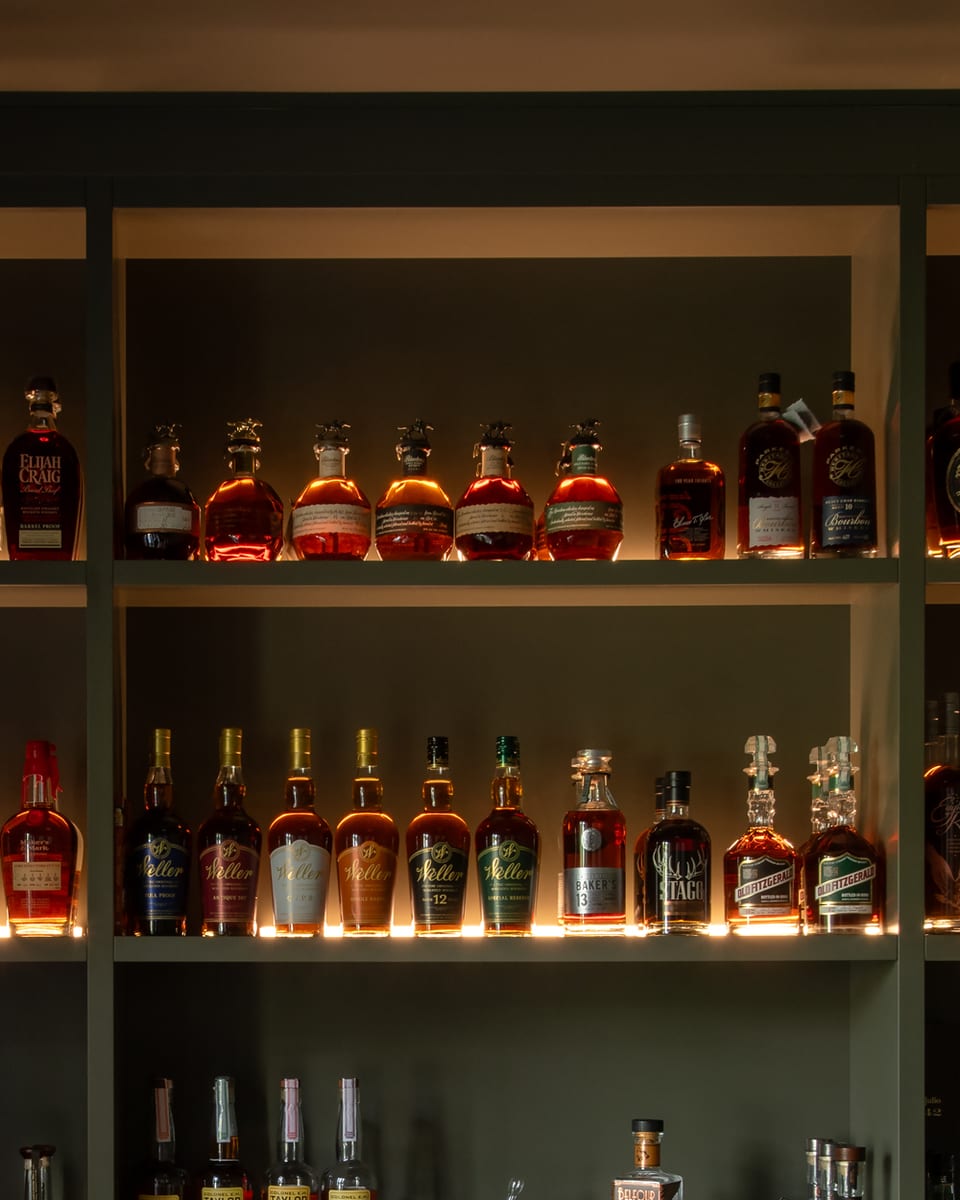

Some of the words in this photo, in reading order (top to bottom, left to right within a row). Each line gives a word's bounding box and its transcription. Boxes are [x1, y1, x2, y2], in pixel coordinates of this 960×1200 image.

[19, 453, 62, 471] ELIJAH
[18, 467, 61, 486] CRAIG
[205, 856, 255, 881] Weller
[276, 858, 323, 881] Weller
[343, 857, 393, 882] Weller
[415, 858, 465, 882] Weller
[484, 856, 533, 881] Weller
[831, 866, 876, 892] FITZGERALD
[575, 879, 618, 891] BAKER'S
[751, 868, 795, 894] FITZGERALD
[432, 893, 448, 905] 12
[576, 893, 589, 907] 13
